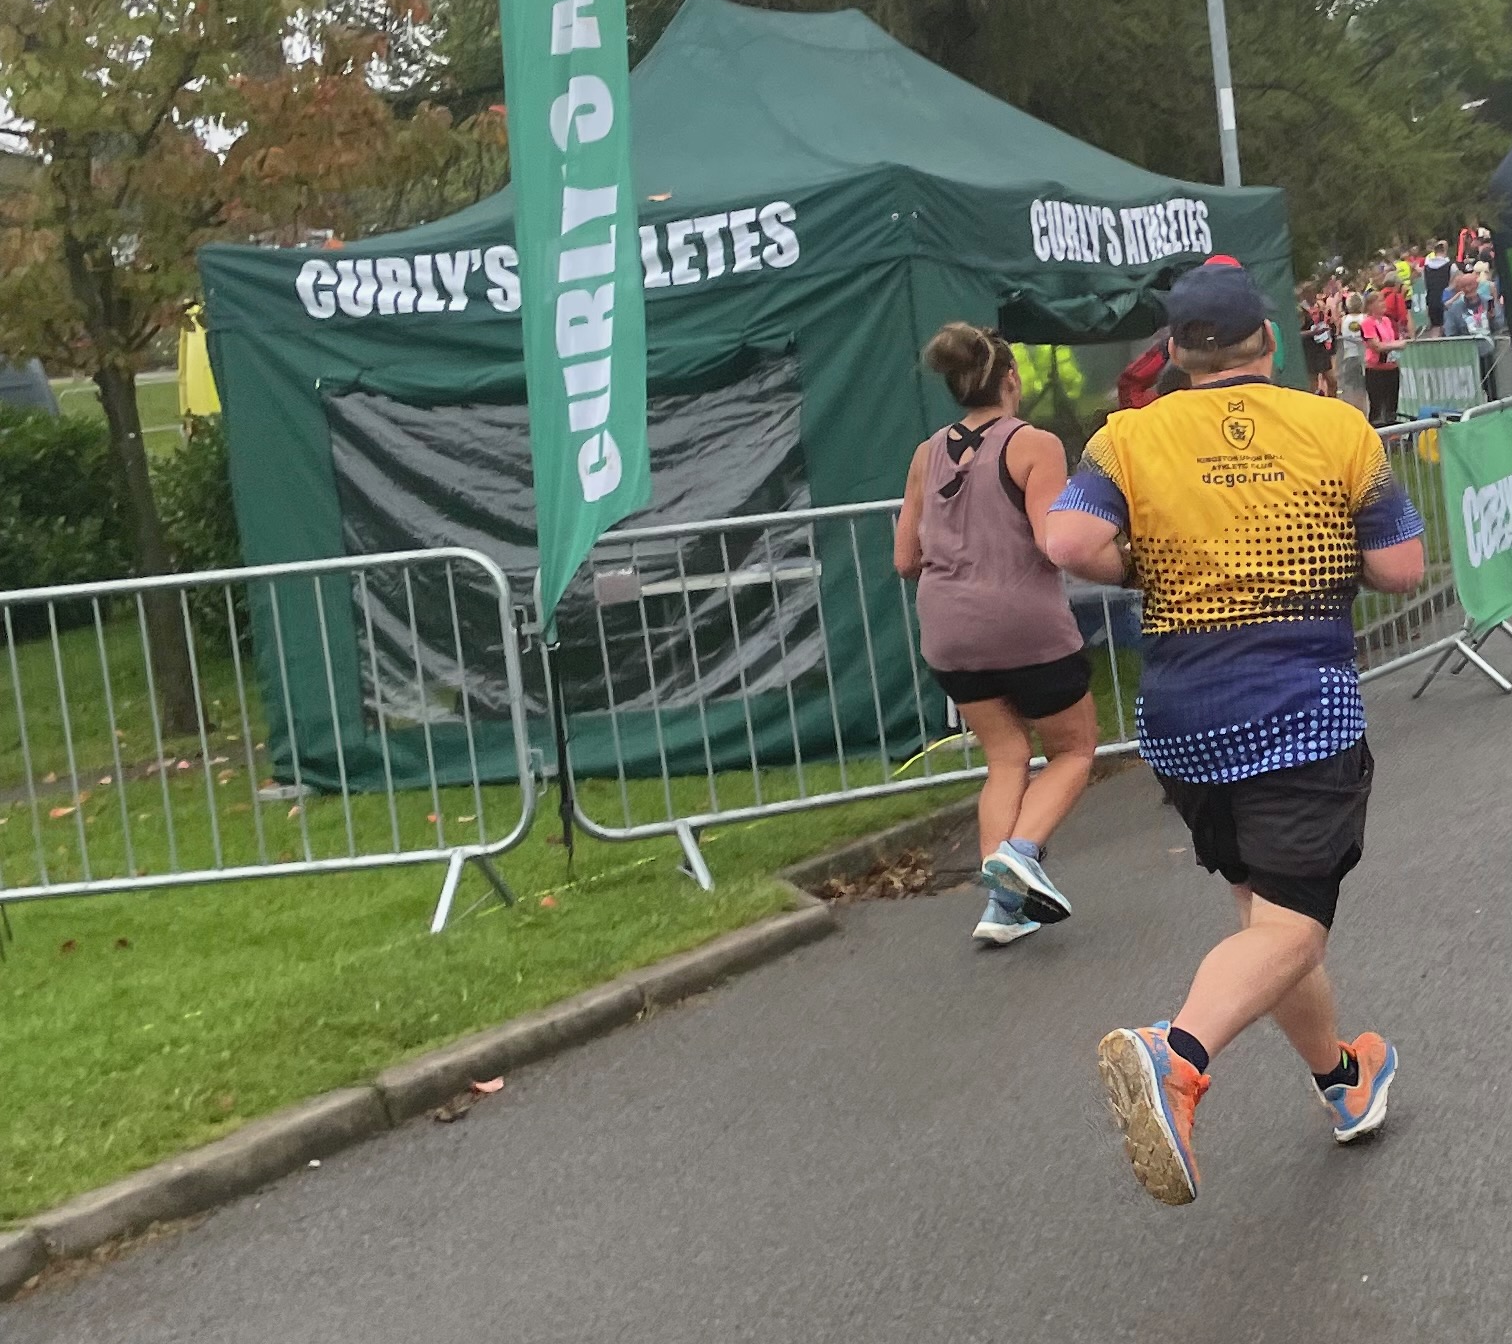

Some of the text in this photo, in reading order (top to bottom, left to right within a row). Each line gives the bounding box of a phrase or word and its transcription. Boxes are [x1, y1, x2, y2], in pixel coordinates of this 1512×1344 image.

[295, 201, 800, 319] CURLY'S LETES
[1030, 198, 1212, 266] CURLY'S ATHLETES
[1202, 471, 1285, 488] dcgo.run
